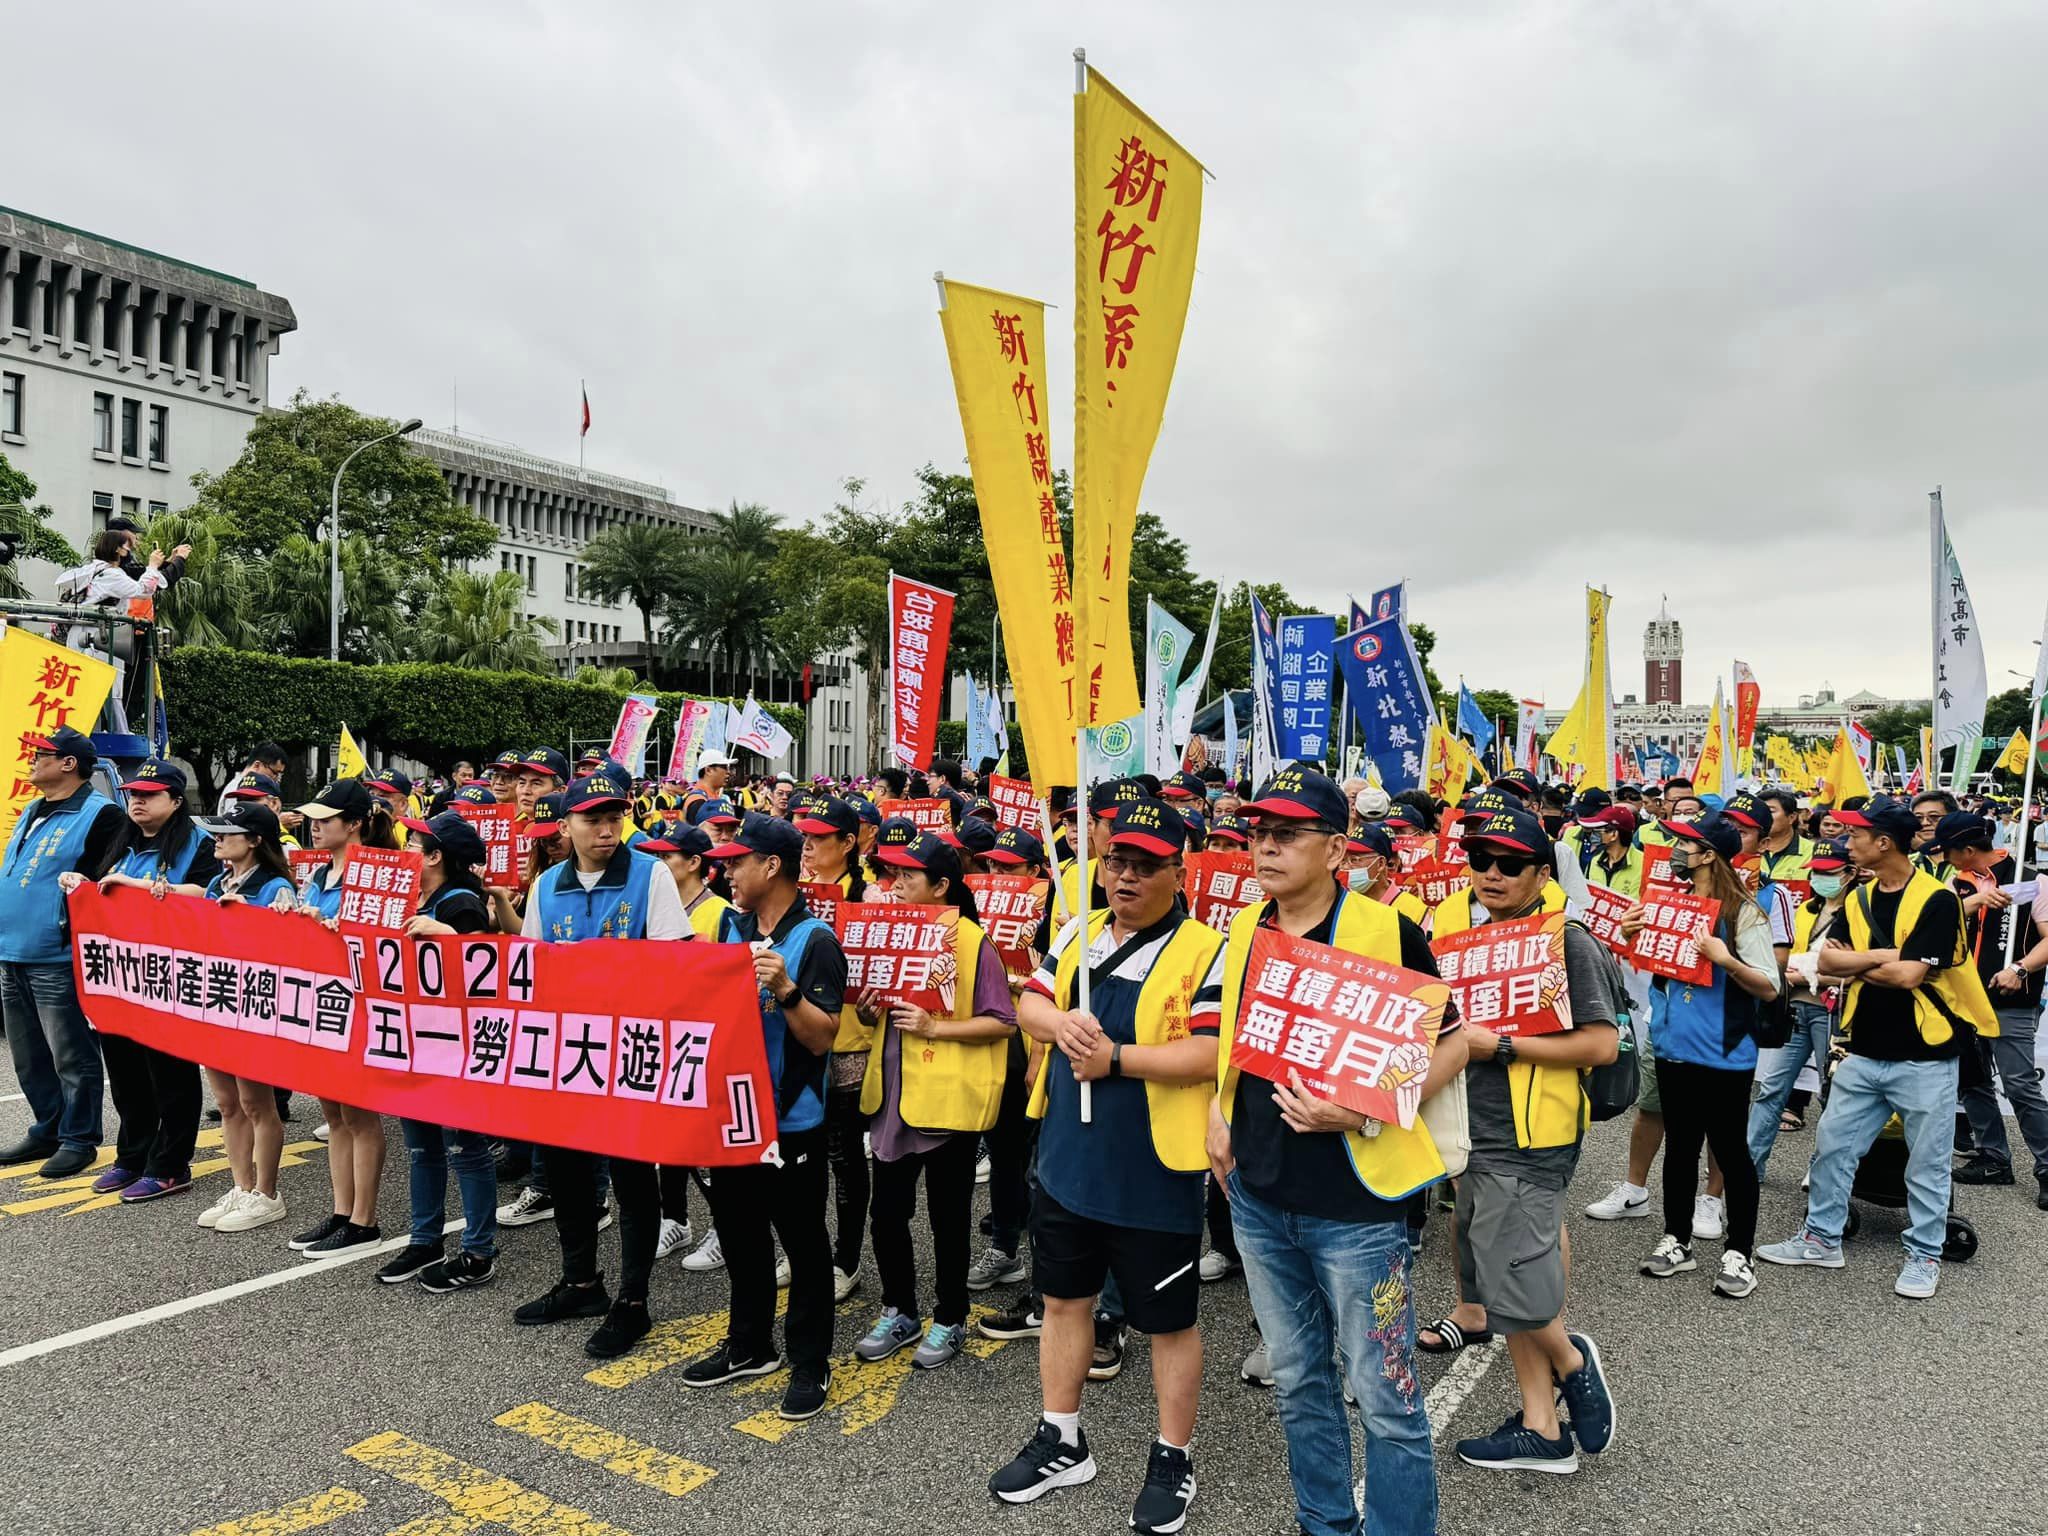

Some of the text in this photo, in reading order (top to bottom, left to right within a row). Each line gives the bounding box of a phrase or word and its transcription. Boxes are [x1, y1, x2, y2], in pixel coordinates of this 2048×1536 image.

[842, 921, 949, 952] 連續執政
[1291, 946, 1318, 960] 2024
[1437, 933, 1554, 981] 連續執政
[83, 939, 354, 1036] 新竹縣產業總工會
[1255, 957, 1430, 1040] 連續執政
[1238, 1001, 1395, 1088] 無蜜月
